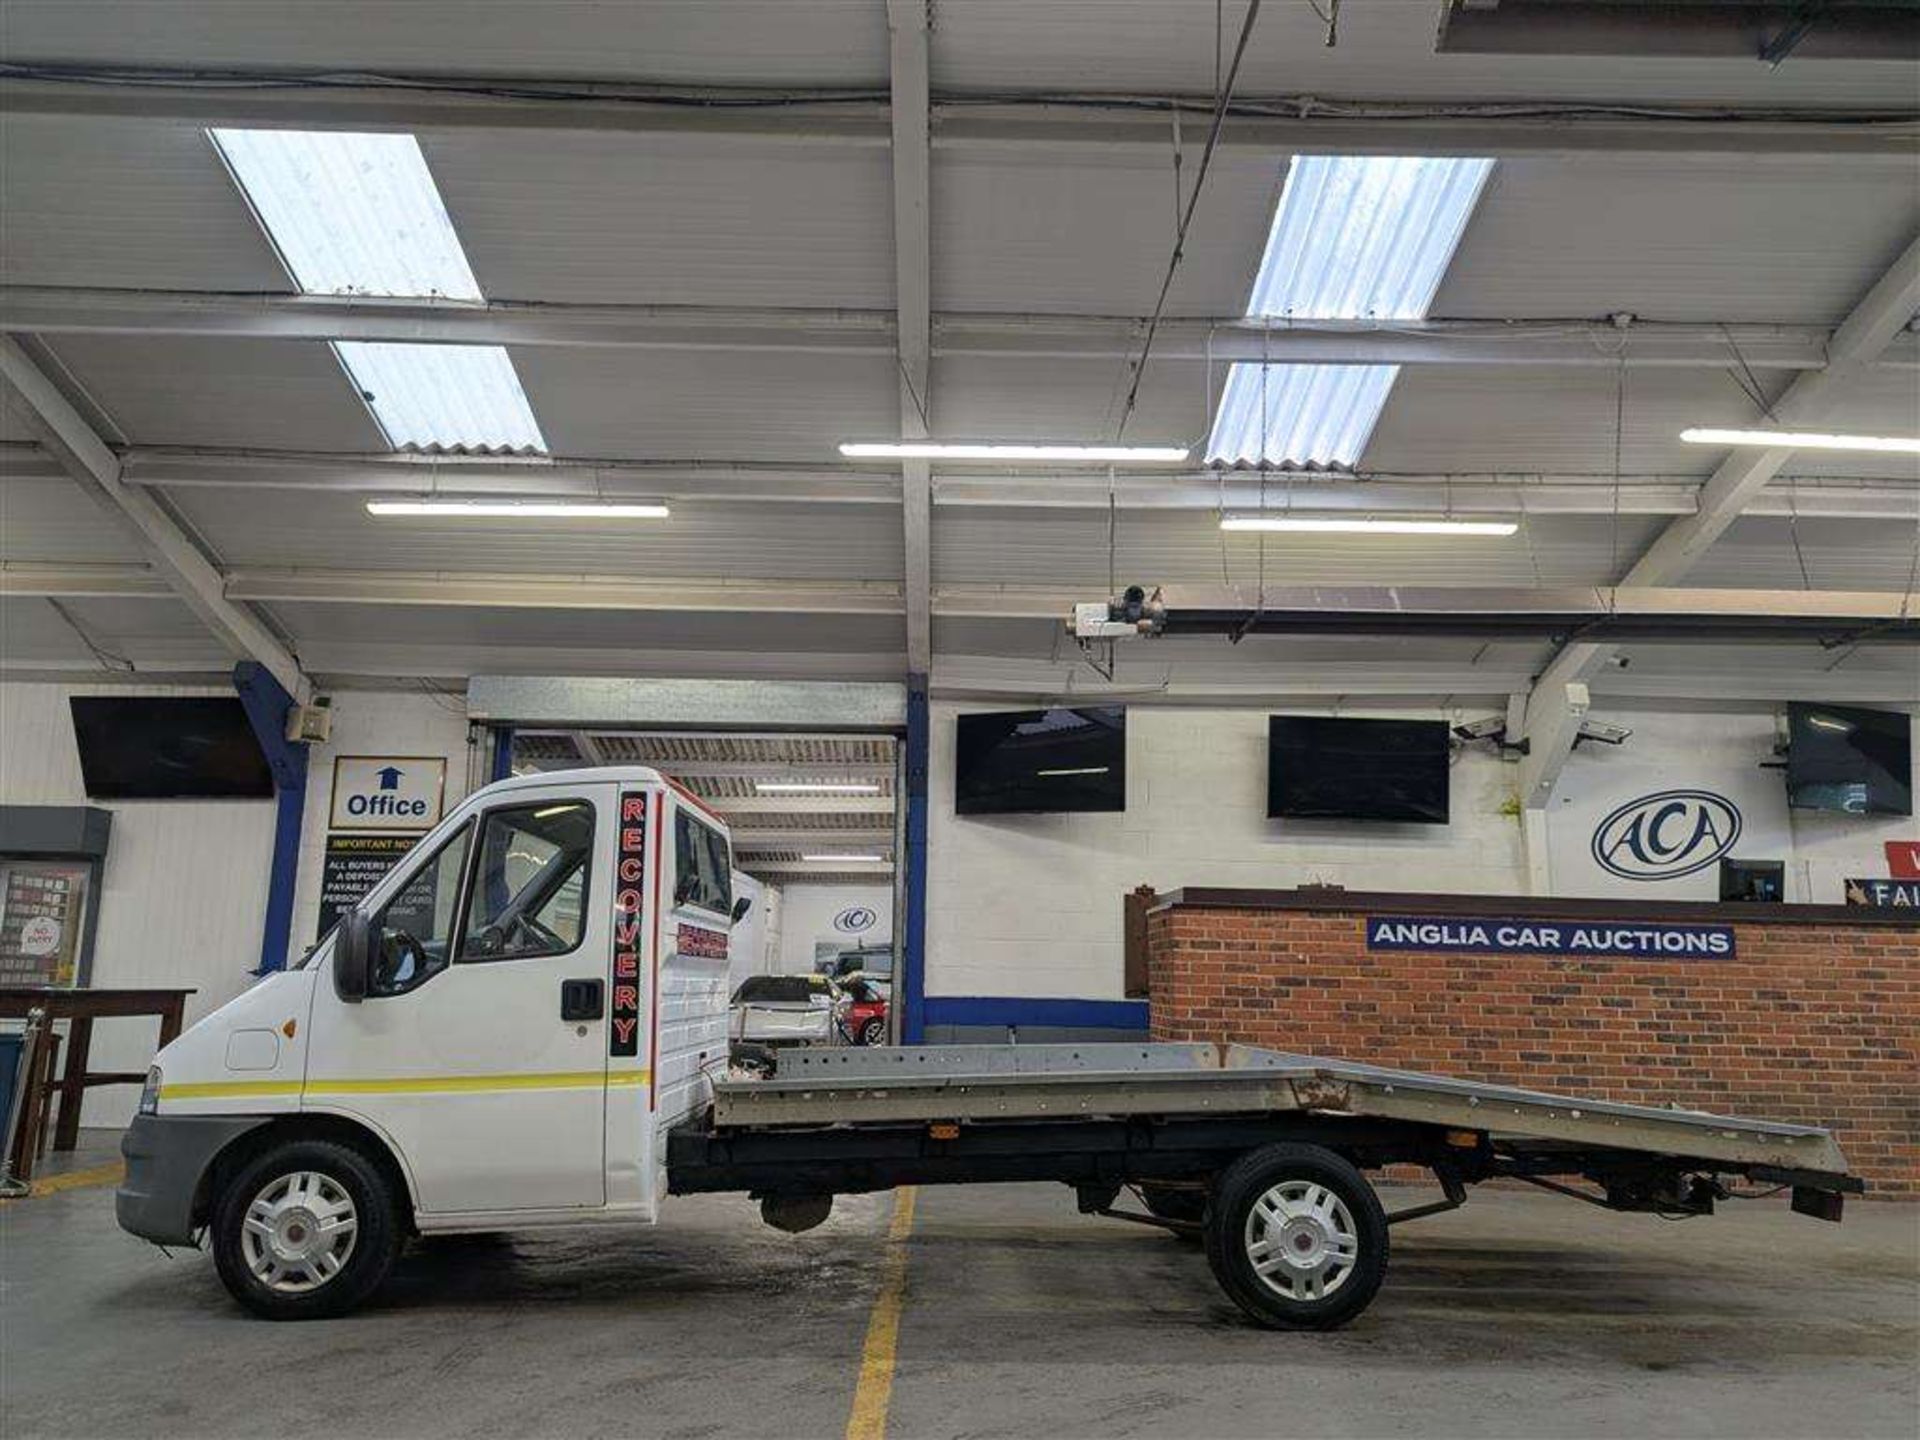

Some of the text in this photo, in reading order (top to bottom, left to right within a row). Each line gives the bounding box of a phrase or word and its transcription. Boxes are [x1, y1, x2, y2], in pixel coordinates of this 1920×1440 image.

[347, 795, 426, 815] Office
[332, 839, 392, 849] IMPORTANT
[1605, 800, 1723, 865] ACA
[329, 861, 346, 870] ALL
[614, 798, 644, 1044] RECOVERY
[1374, 923, 1730, 953] ANGLIA CAR AUCTIONS
